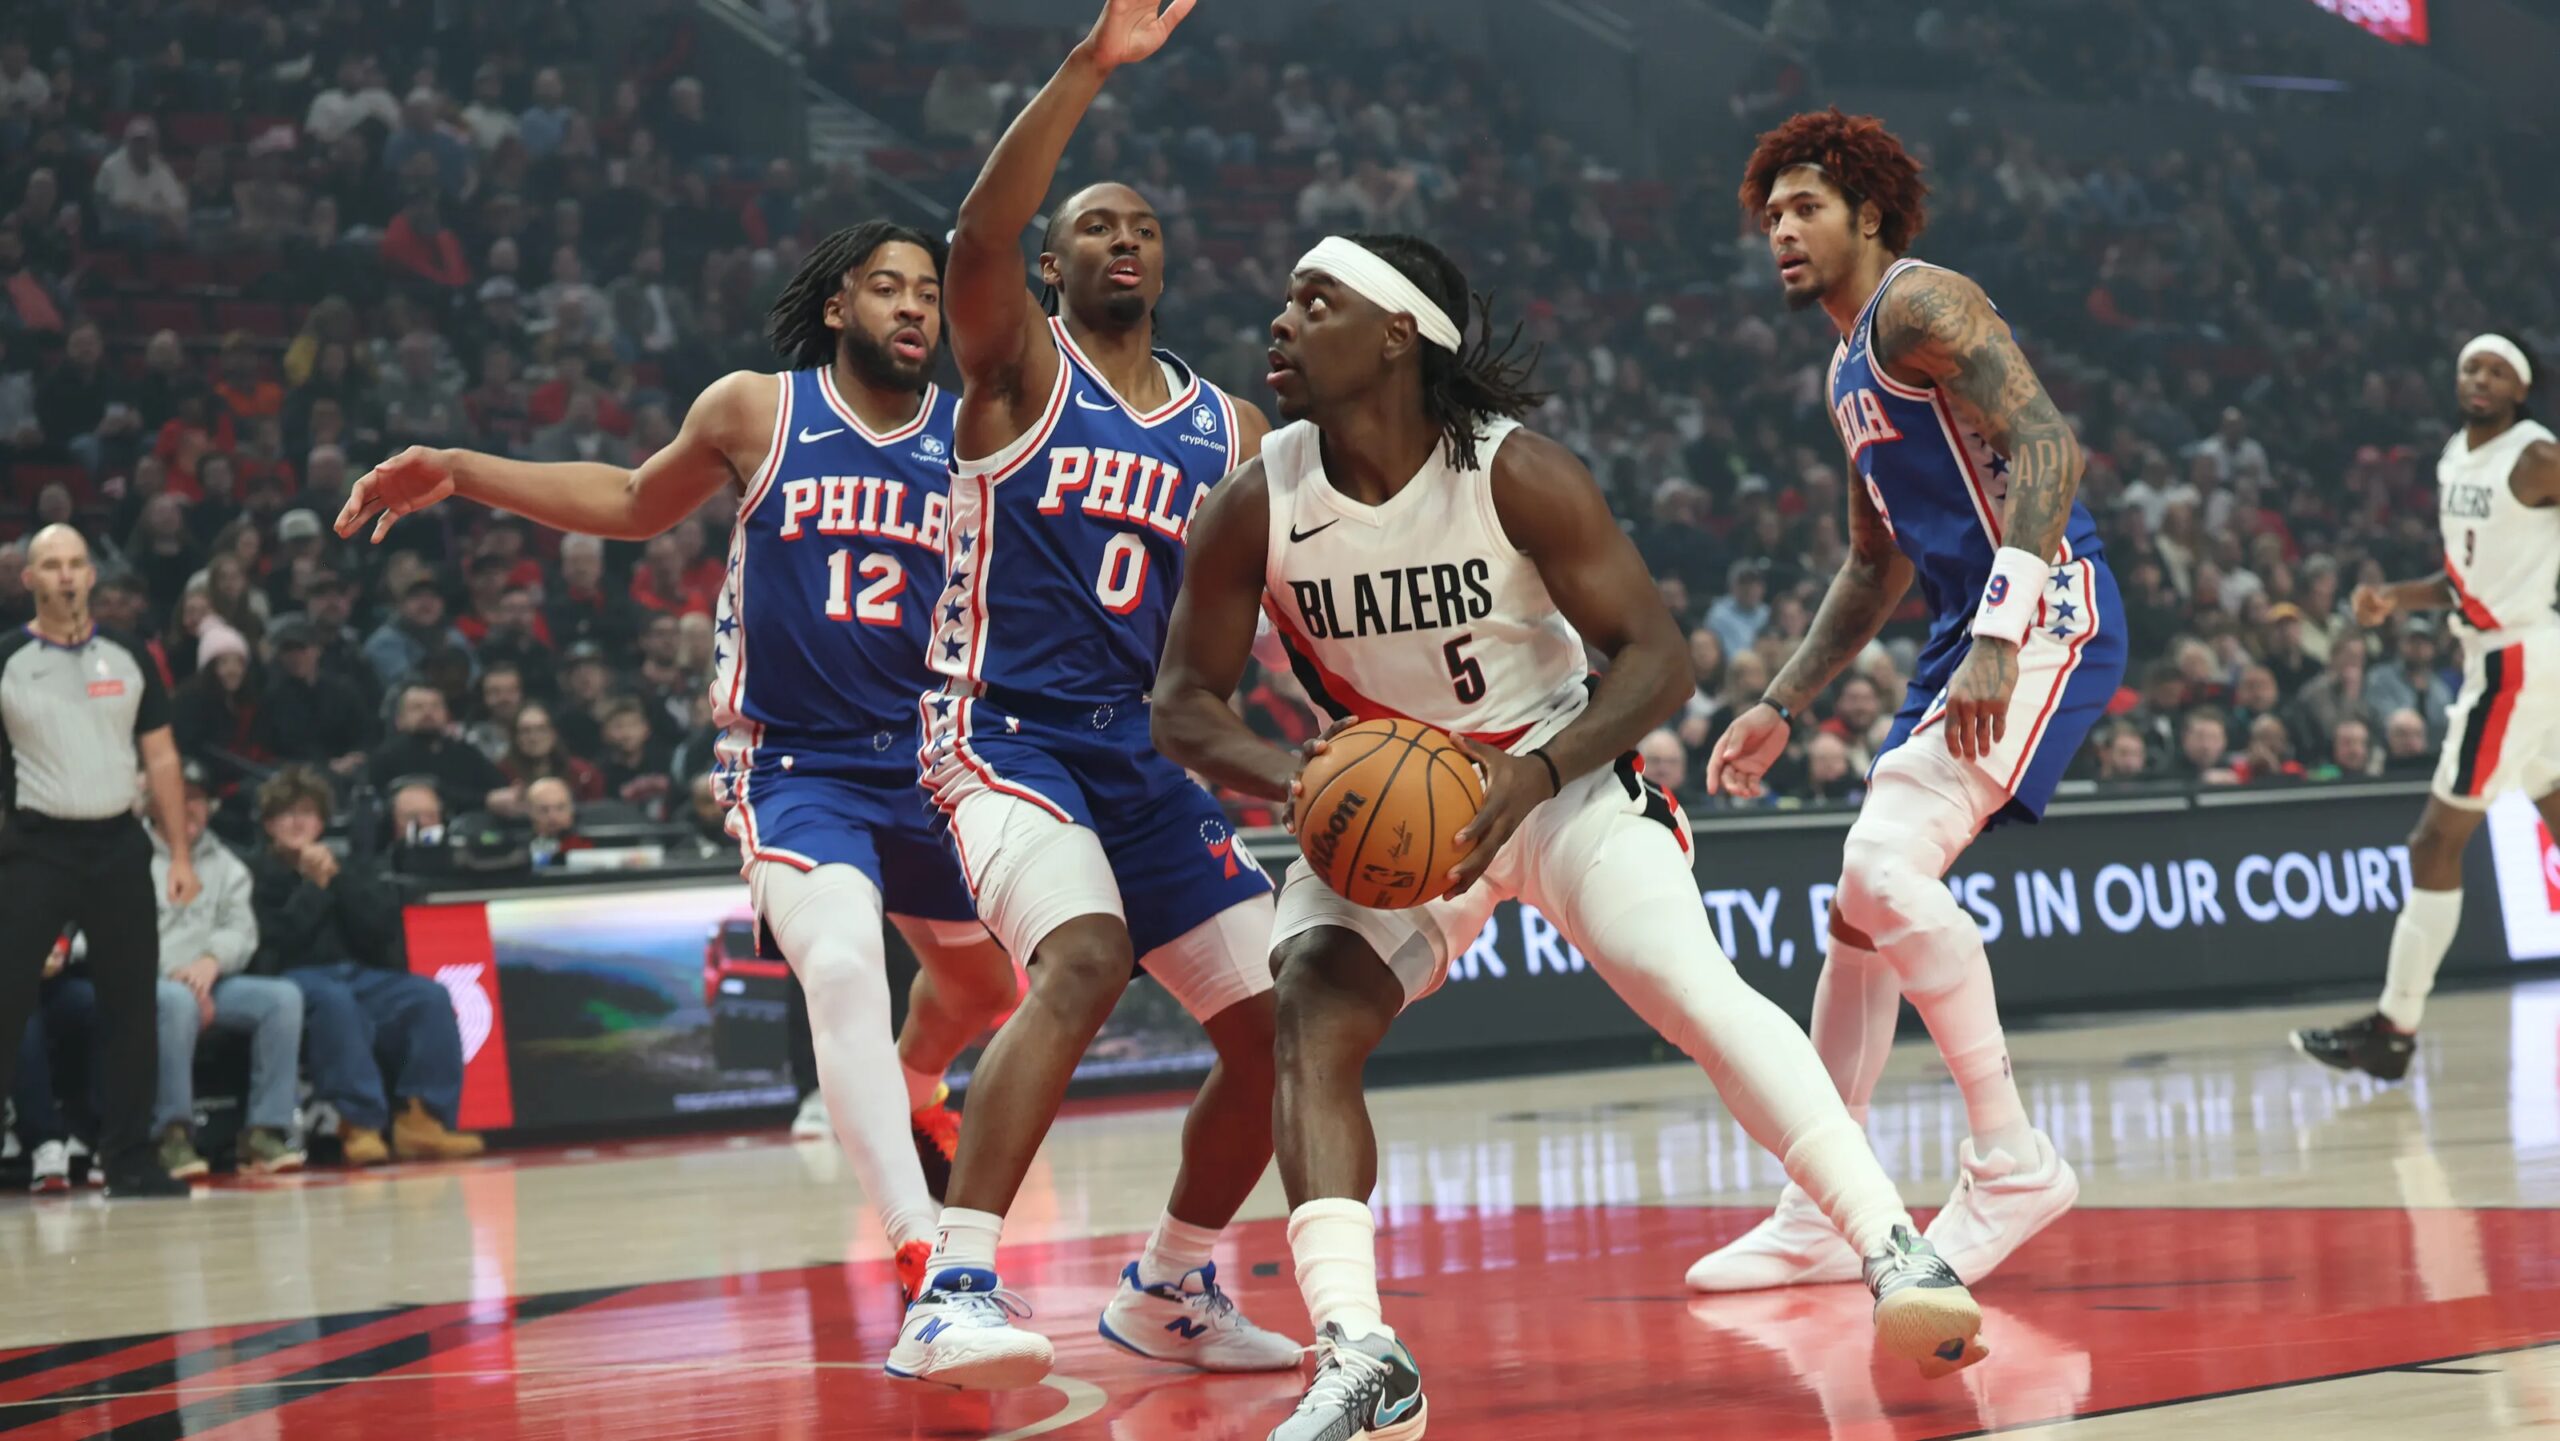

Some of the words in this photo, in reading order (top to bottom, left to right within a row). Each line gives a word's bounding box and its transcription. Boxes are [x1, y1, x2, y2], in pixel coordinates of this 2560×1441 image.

[1180, 434, 1226, 454] crypto.com
[825, 548, 903, 627] 12
[1096, 531, 1152, 616] 0
[1287, 558, 1492, 640] BLAZERS
[1986, 574, 2010, 608] 9
[1443, 633, 1486, 705] 5
[2014, 867, 2081, 939] IN
[2093, 858, 2227, 933] OUR
[2234, 845, 2413, 923] COURT
